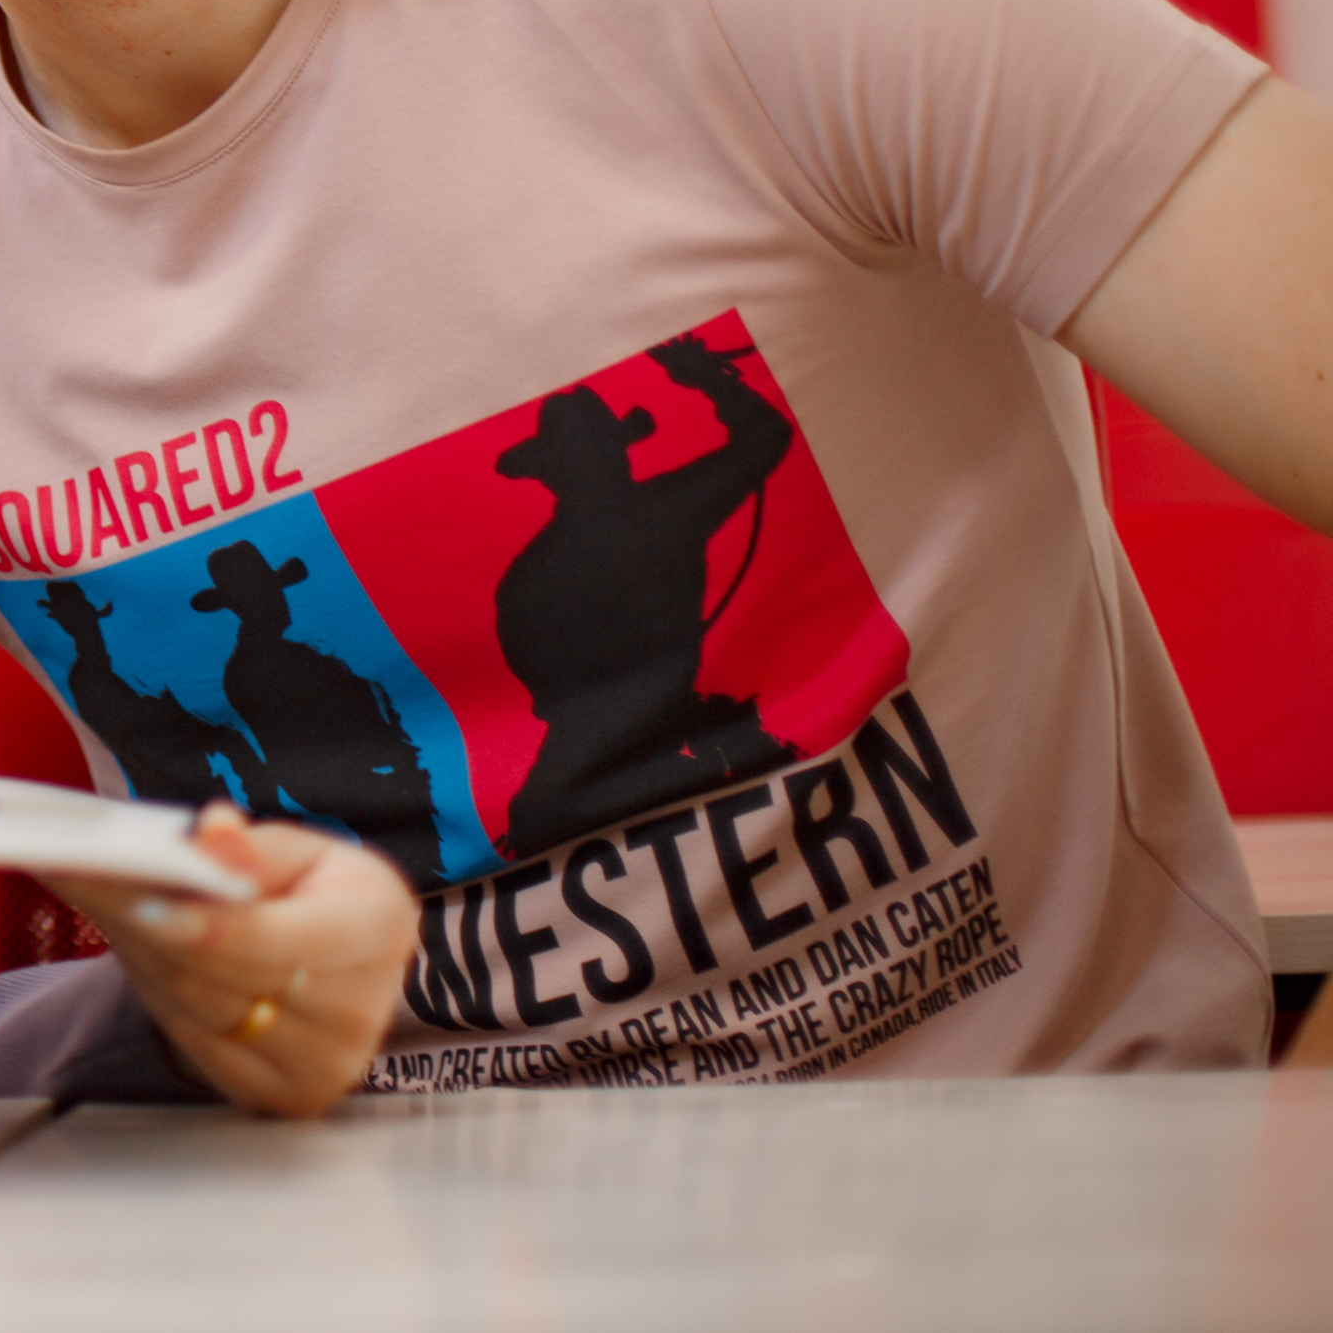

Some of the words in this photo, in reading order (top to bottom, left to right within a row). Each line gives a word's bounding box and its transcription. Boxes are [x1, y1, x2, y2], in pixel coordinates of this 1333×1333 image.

[403, 689, 978, 1032] WESTERN
[435, 1043, 565, 1087] CREATED
[620, 988, 728, 1050] DEAN
[729, 956, 808, 1021] AND
[805, 913, 891, 987] DAN
[886, 856, 995, 949] CATEN
[689, 1030, 761, 1082] AND
[755, 1000, 832, 1063] THE
[827, 949, 928, 1036] CRAZY
[934, 900, 1010, 979] ROPE
[831, 1043, 848, 1071] IN
[956, 974, 979, 1000] IN
[976, 944, 1024, 989] ITALY
